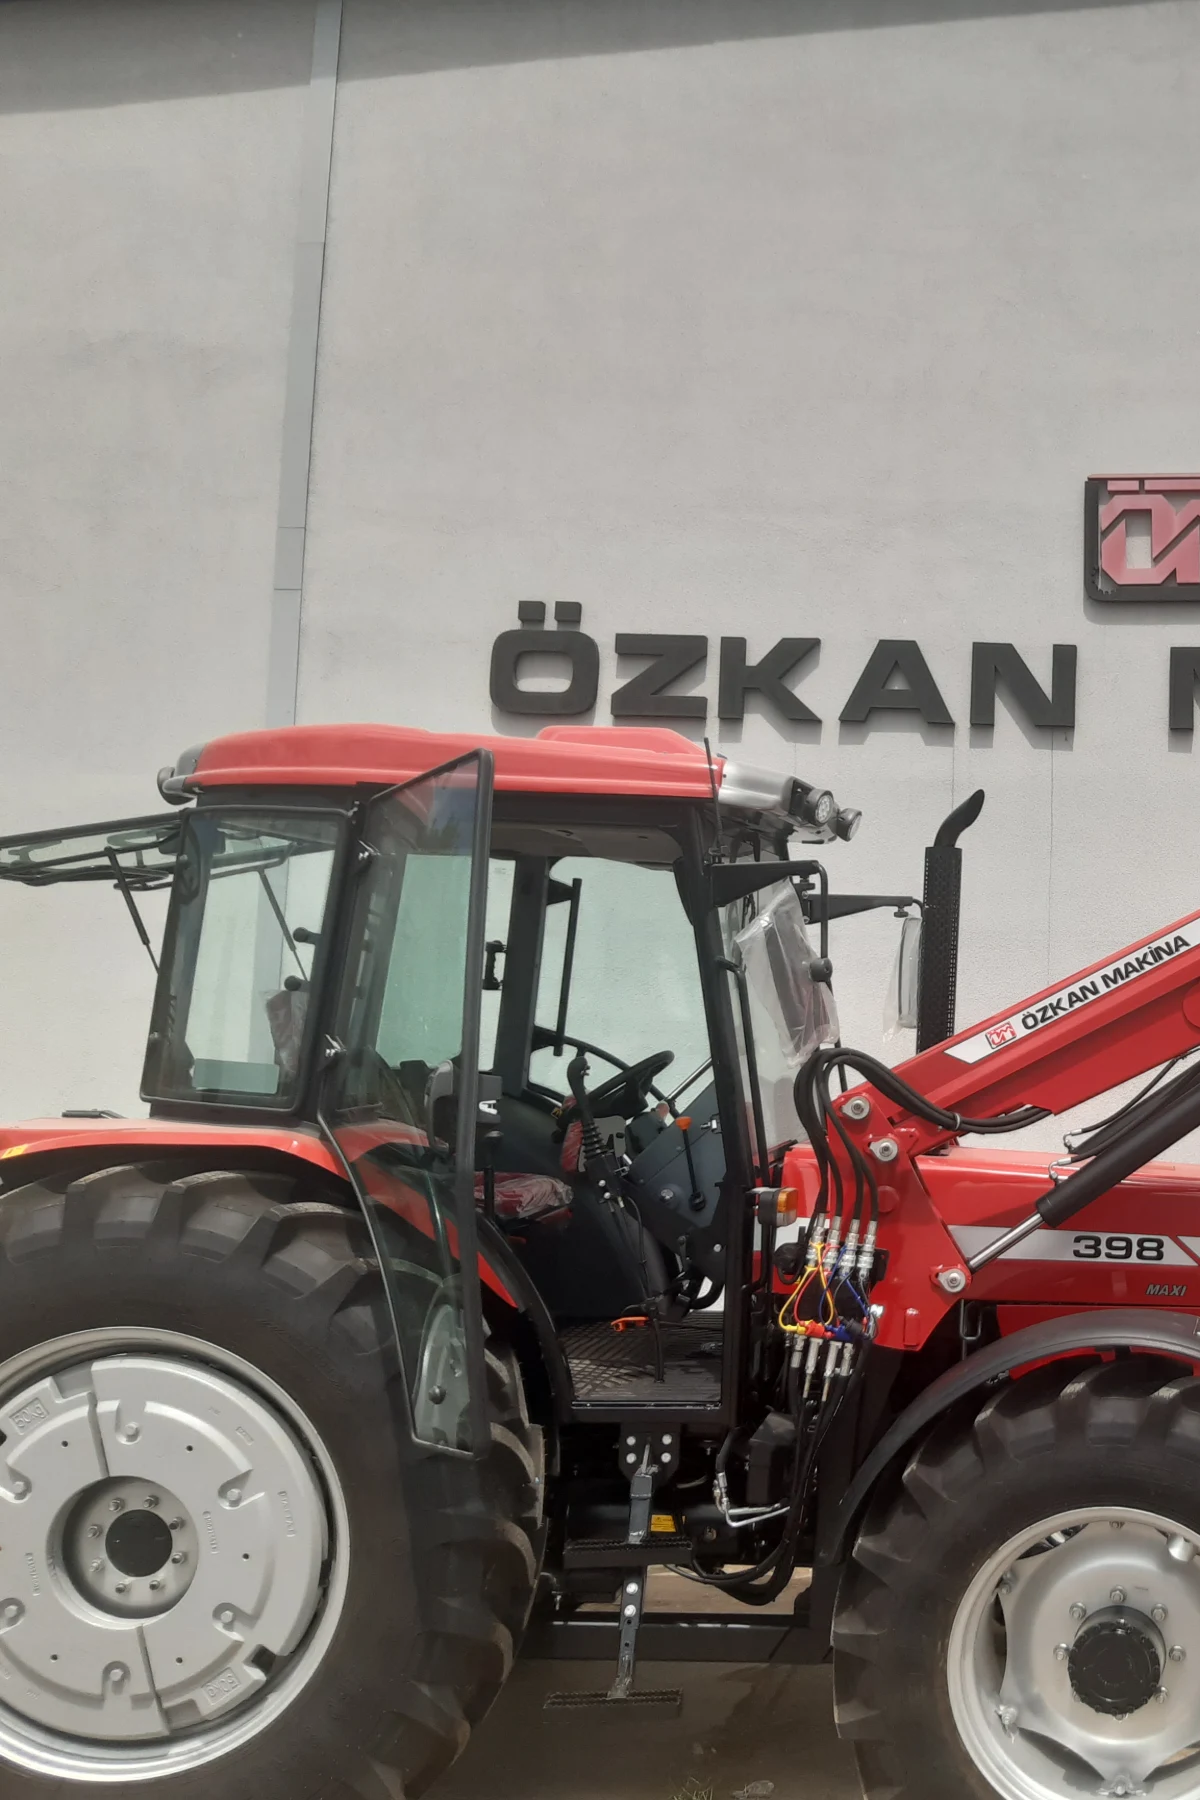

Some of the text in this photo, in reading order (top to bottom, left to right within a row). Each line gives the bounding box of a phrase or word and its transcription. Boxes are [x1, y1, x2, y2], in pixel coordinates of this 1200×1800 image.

[489, 600, 1077, 726] ÖZKAN
[1021, 935, 1190, 1031] ÖZKAN MAKİNA
[1072, 1235, 1165, 1261] 398
[1146, 1284, 1187, 1296] MAXI
